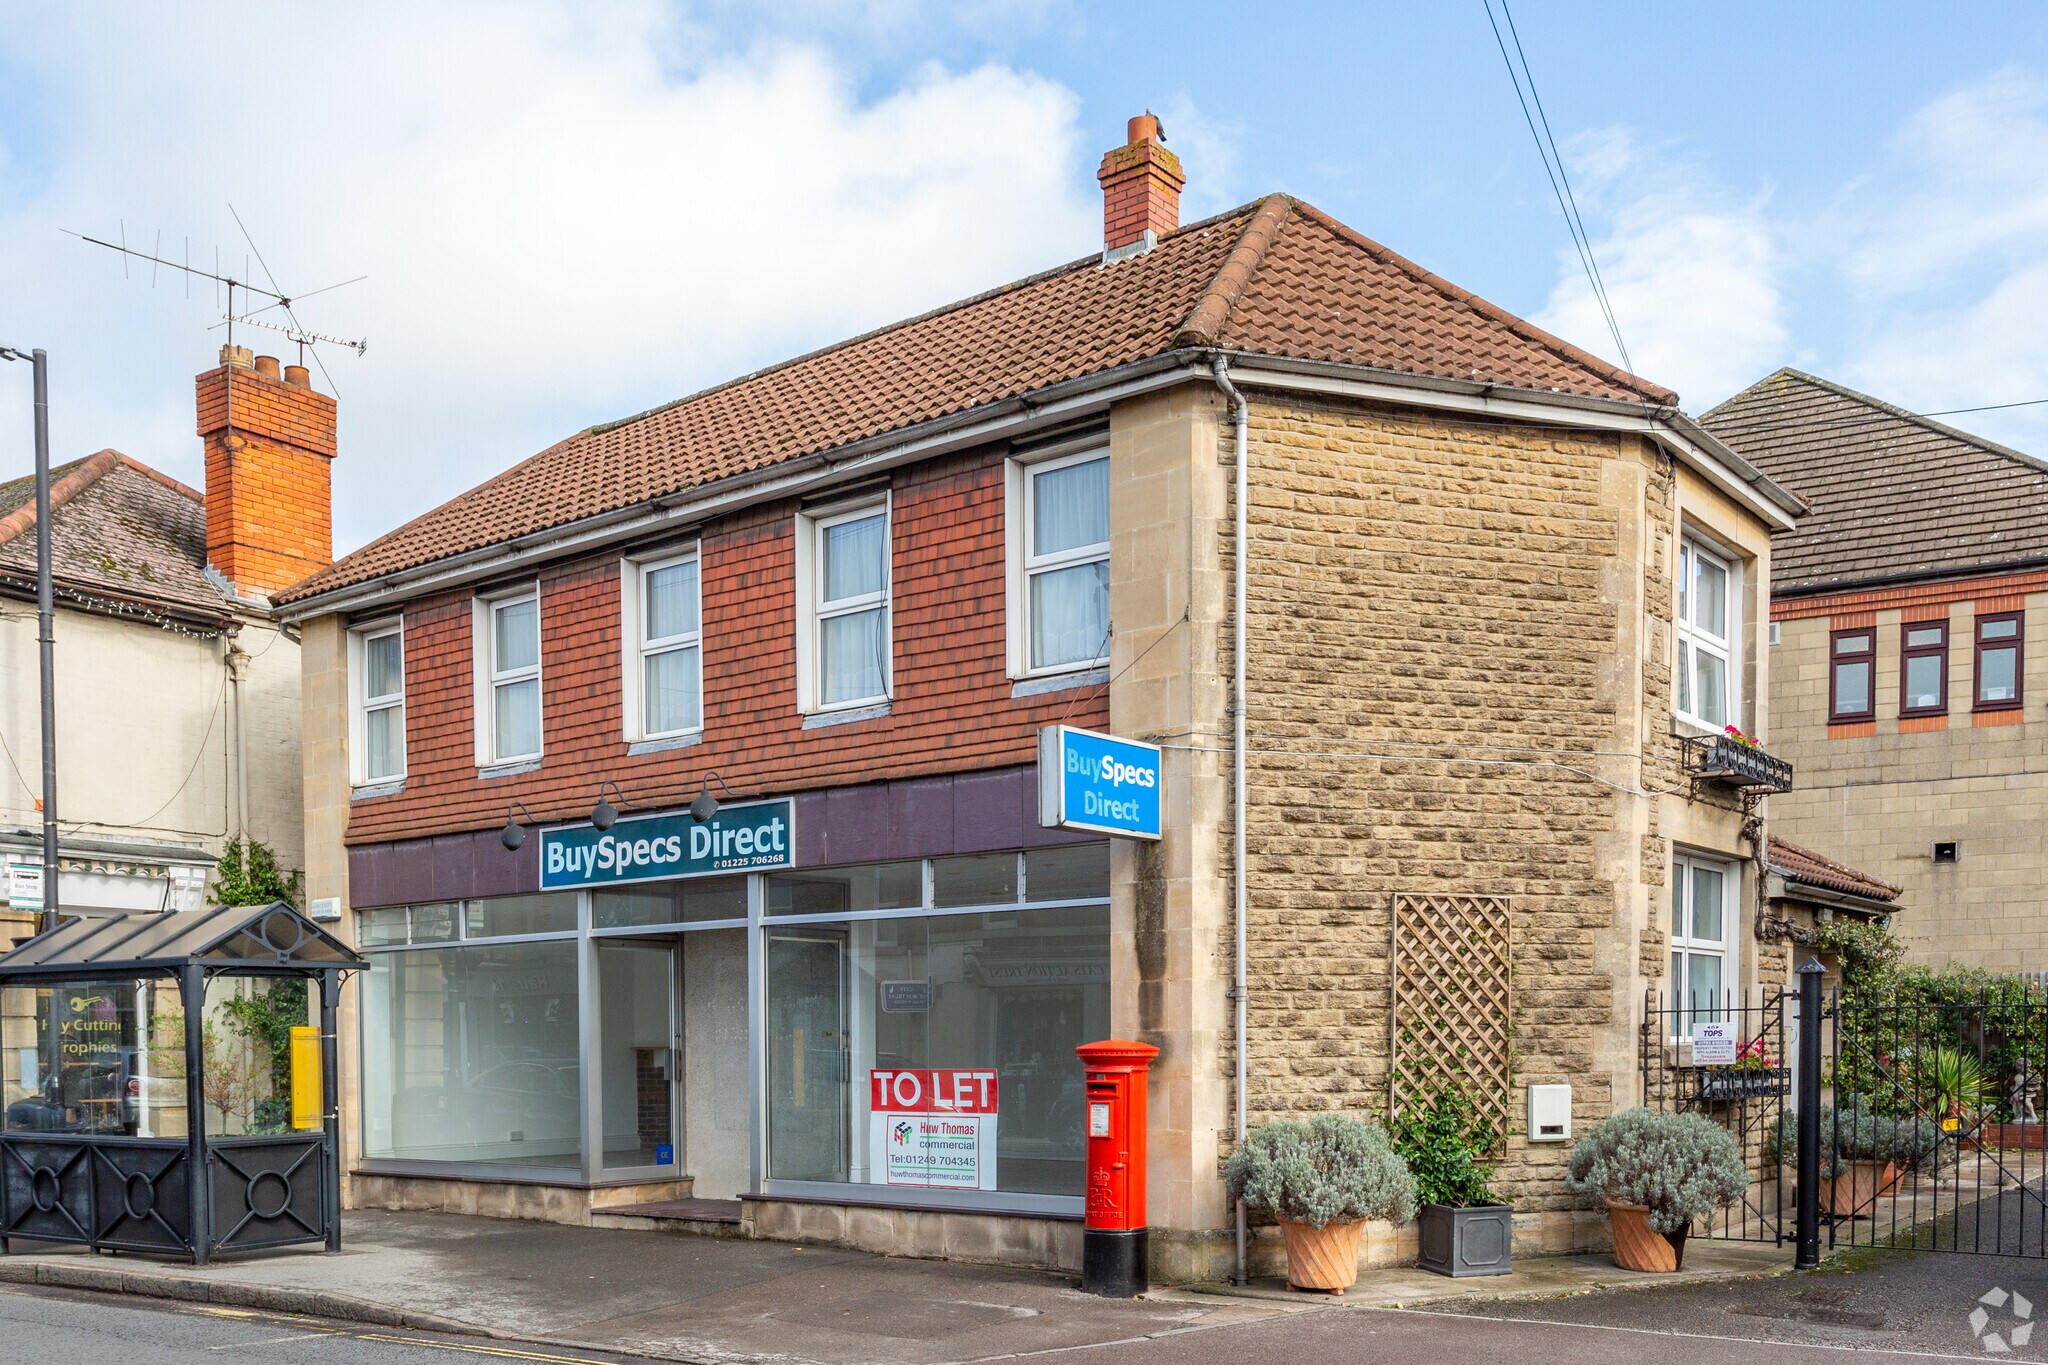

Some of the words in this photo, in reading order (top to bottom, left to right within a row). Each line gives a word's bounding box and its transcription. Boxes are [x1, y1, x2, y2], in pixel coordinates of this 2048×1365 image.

[1067, 748, 1155, 788] BuySpecs
[1084, 790, 1140, 822] Direct
[547, 835, 681, 878] BuySpecs
[690, 817, 785, 860] Direct
[721, 857, 749, 868] 01225
[751, 854, 785, 865] 706268
[42, 1019, 70, 1034] Ky
[61, 1042, 117, 1056] rophies
[873, 1071, 922, 1107] TO
[932, 1072, 994, 1108] LET
[920, 1122, 939, 1134] Huw
[941, 1122, 975, 1135] Thomas
[919, 1140, 975, 1150] commercial
[939, 1156, 976, 1167] 704345
[890, 1170, 976, 1181] huwthomascommercial.com
